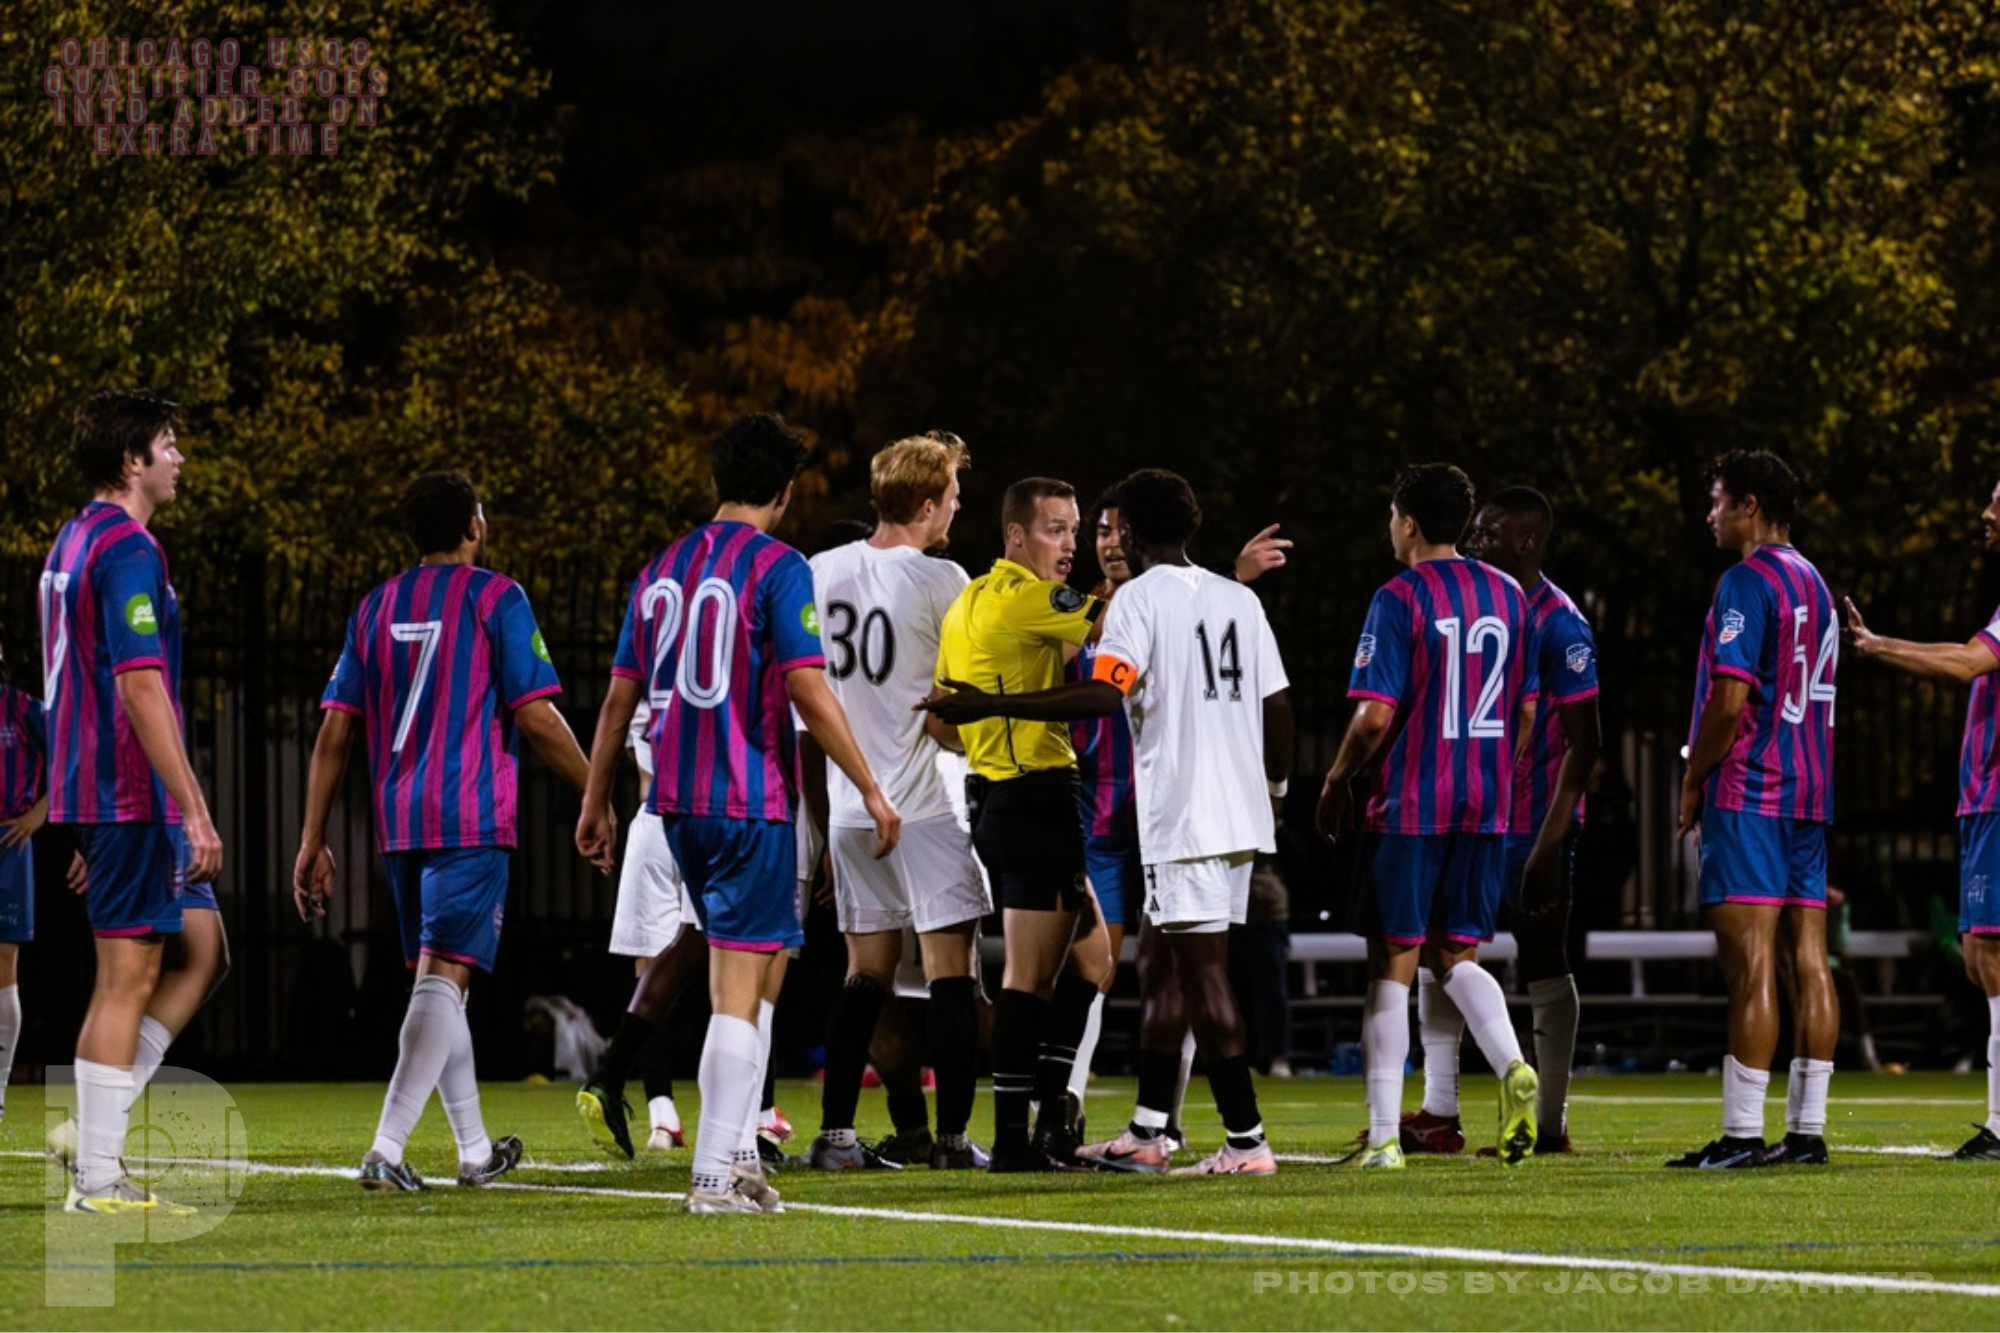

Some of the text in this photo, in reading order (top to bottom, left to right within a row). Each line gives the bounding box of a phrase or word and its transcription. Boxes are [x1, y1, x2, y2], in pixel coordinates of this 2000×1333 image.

[390, 620, 442, 752] 7
[640, 577, 738, 710] 20
[827, 600, 896, 686] 30
[1111, 662, 1129, 685] C
[1195, 618, 1243, 701] 14
[1434, 616, 1510, 739] 12
[1781, 605, 1840, 728] 54
